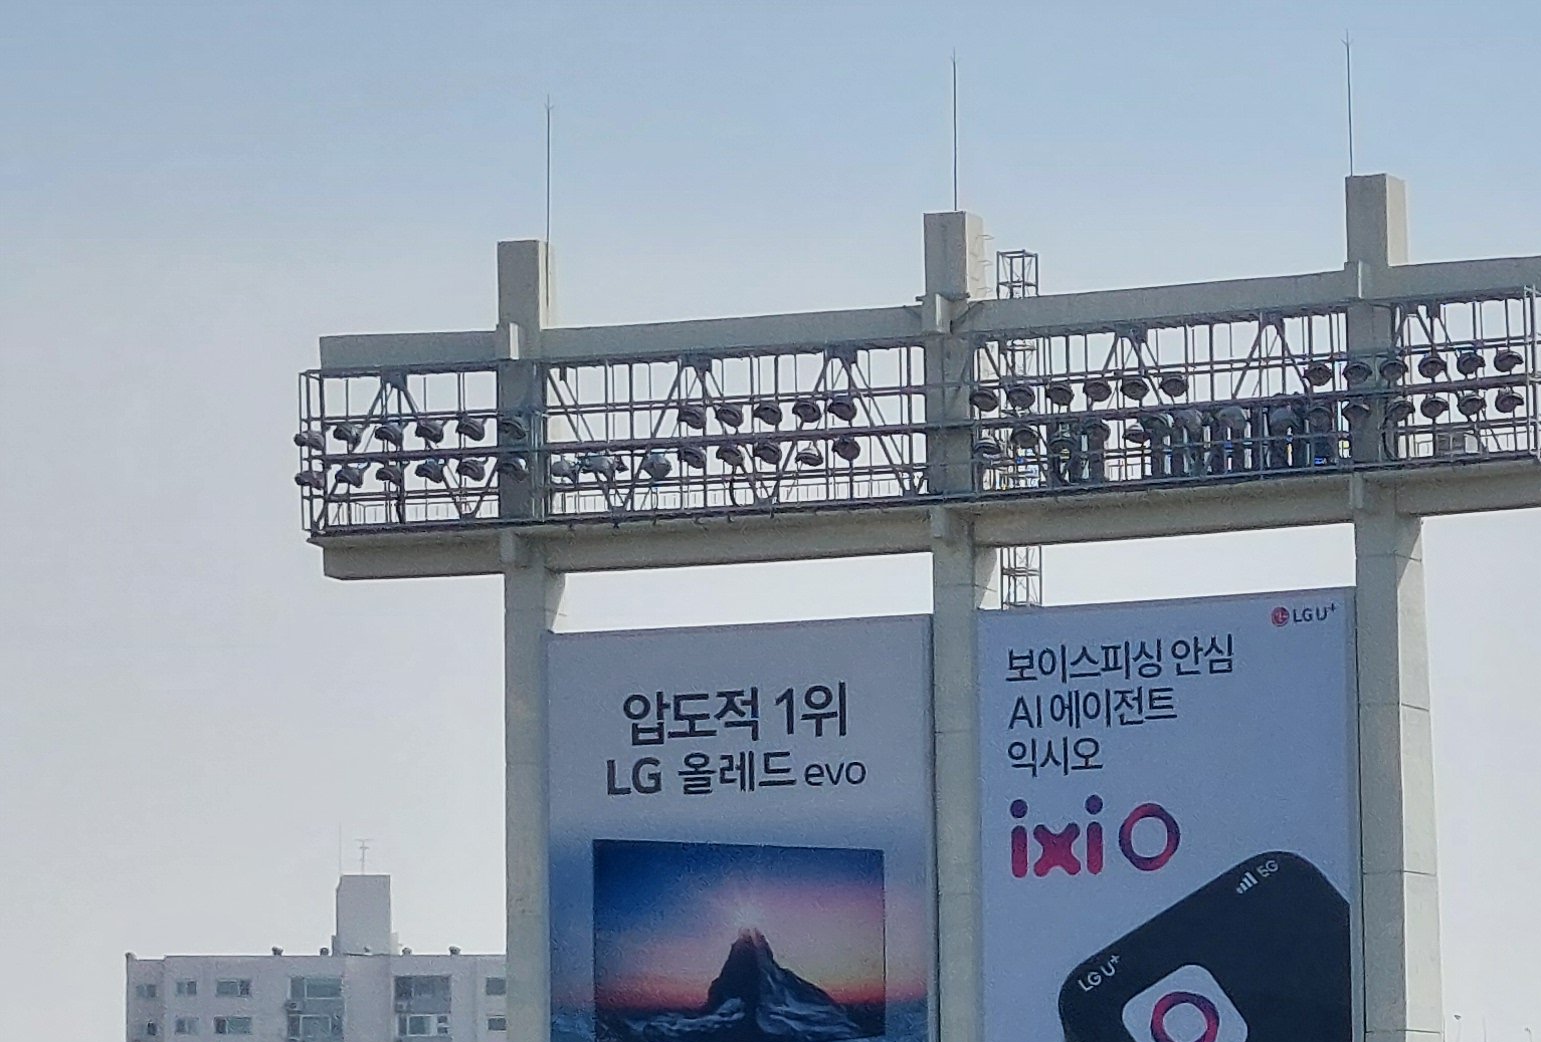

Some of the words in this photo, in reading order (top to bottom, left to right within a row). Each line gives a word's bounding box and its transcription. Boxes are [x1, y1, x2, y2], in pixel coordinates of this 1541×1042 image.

[1005, 638, 1162, 684] 보이스피싱
[1171, 633, 1234, 676] 안심
[623, 686, 760, 746] 압도적
[774, 680, 846, 738] 1위
[1006, 695, 1042, 731] AI
[1050, 686, 1177, 729] 에이전트
[607, 757, 662, 796] LG
[677, 751, 797, 795] 올레드
[804, 762, 866, 786] evo
[1008, 736, 1103, 779] 익시오
